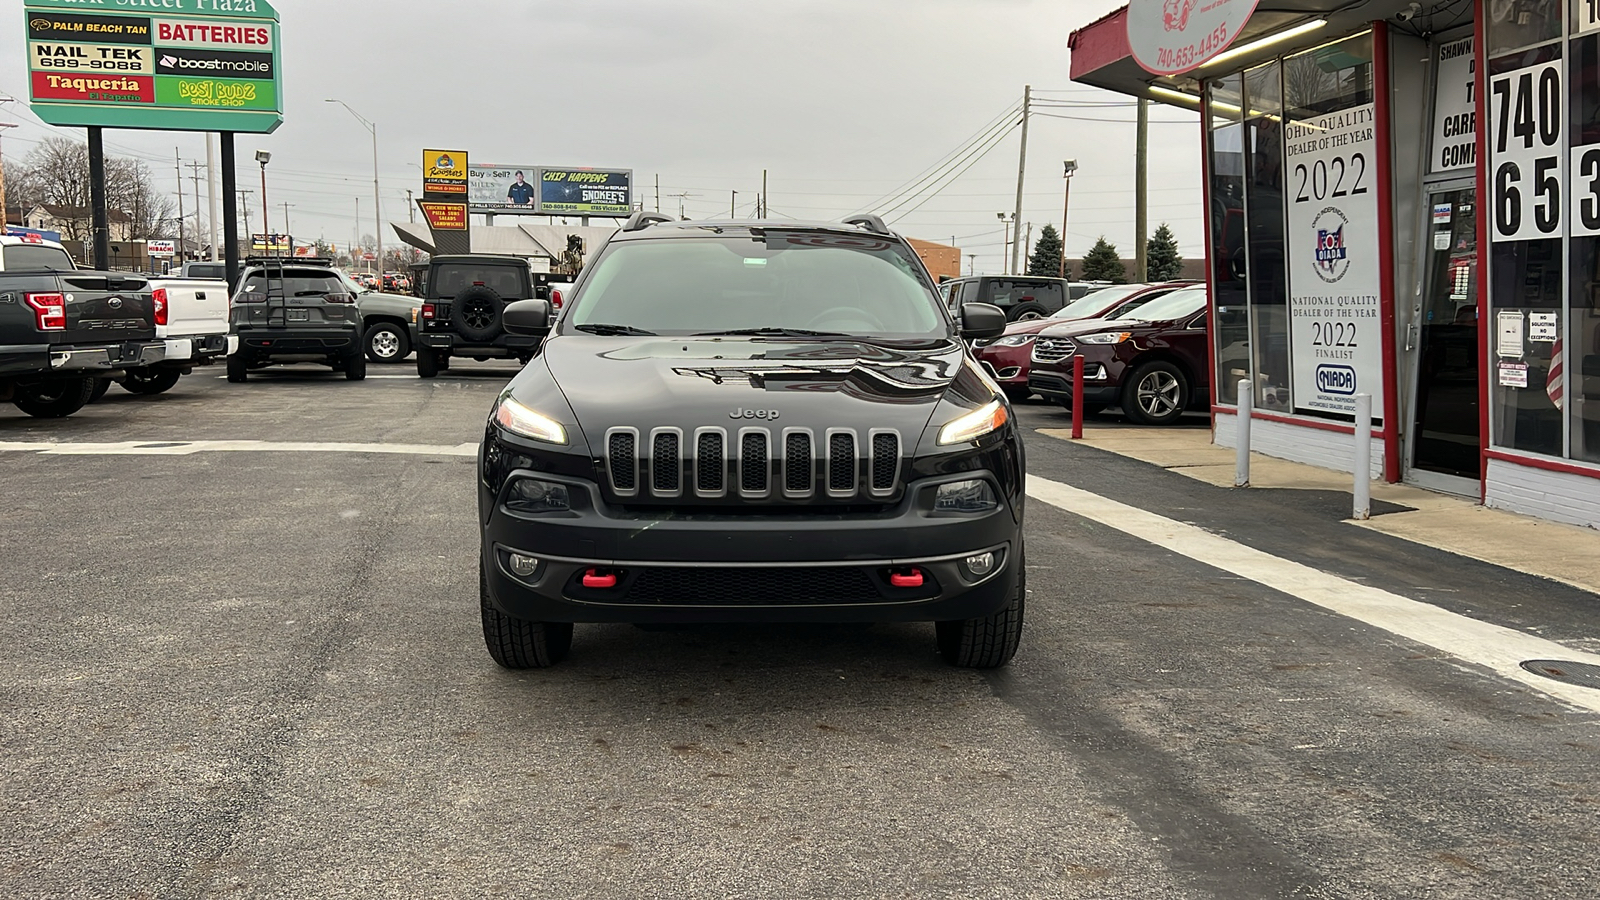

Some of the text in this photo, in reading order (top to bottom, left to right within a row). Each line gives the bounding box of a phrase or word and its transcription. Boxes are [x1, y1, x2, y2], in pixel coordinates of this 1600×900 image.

[53, 22, 147, 34] PALM BEACH TAN
[159, 23, 269, 45] BATTERIES
[1157, 21, 1227, 68] 740-653-4455
[1440, 39, 1472, 61] SHAWN
[37, 45, 142, 60] NAIL TEK
[40, 58, 142, 71] 689-9088
[221, 99, 245, 107] SHOP
[1493, 66, 1560, 153] 740
[1286, 107, 1374, 140] OHIO QUALITY
[1287, 128, 1373, 156] DEALER OF THE YEAR
[470, 170, 485, 178] Buy
[543, 172, 608, 183] CHIP HAPPENS
[1295, 152, 1367, 203] 2022
[582, 190, 625, 203] SNOKEE'S
[1319, 248, 1342, 260] OIADA
[1292, 295, 1377, 307] NATIONAL QUALITY
[1293, 309, 1377, 318] DEALER OF THE YEAR
[1312, 321, 1358, 347] 2022
[1315, 349, 1353, 360] FINALIST
[1319, 370, 1352, 388] NIADA
[729, 407, 780, 421] Jeep
